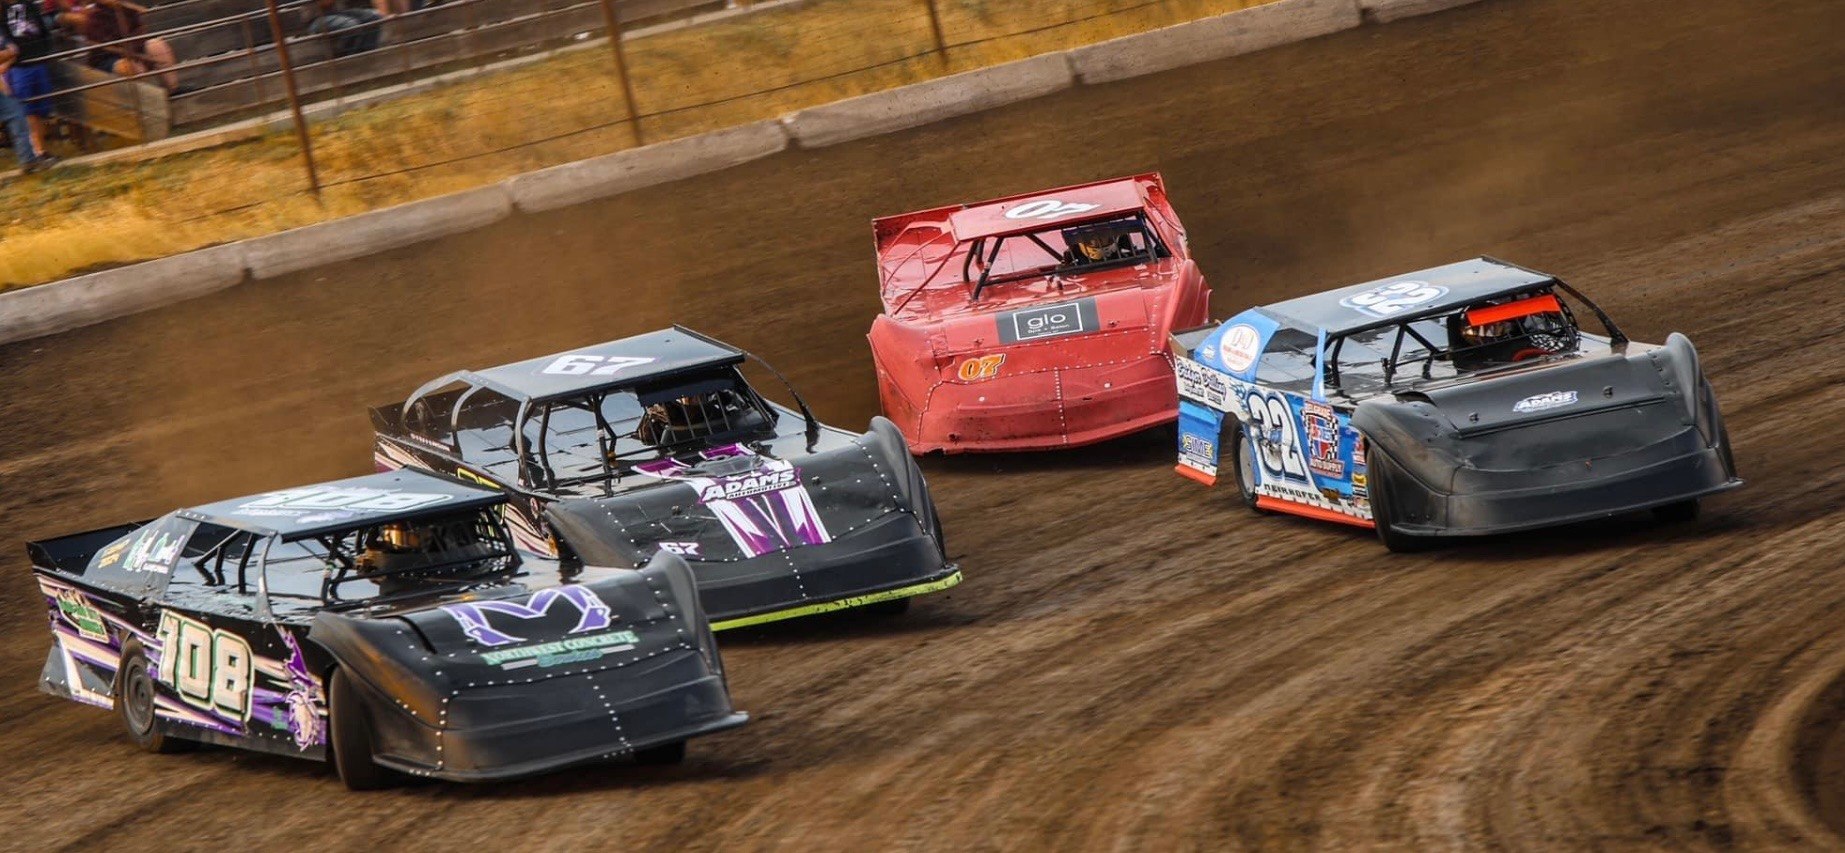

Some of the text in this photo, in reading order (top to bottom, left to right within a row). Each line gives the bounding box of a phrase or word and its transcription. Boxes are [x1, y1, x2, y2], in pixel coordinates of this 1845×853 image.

[1005, 200, 1101, 219] 07
[1027, 314, 1066, 329] glo
[541, 354, 656, 376] 67
[958, 353, 1006, 380] 07
[1247, 390, 1309, 483] 32
[702, 469, 796, 501] ADAMS
[238, 488, 454, 513] 108
[658, 541, 700, 556] 67
[156, 609, 256, 723] 108
